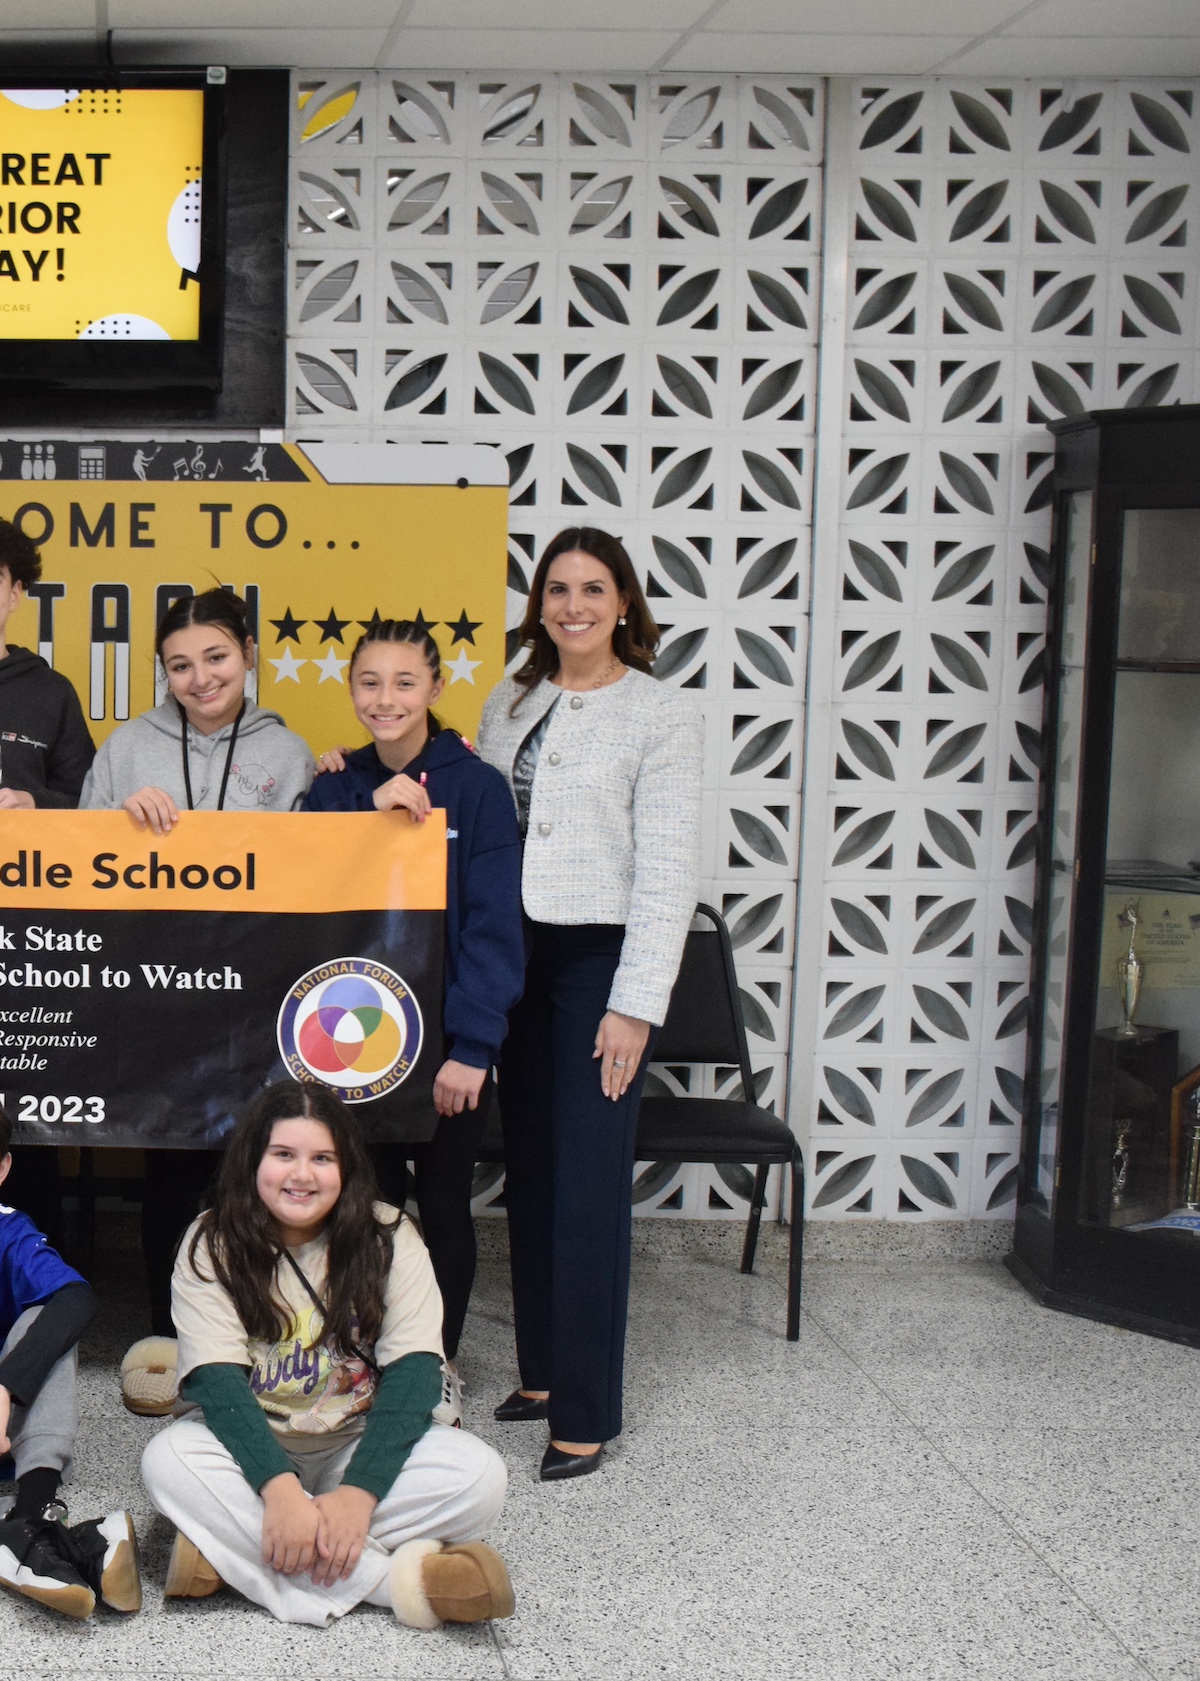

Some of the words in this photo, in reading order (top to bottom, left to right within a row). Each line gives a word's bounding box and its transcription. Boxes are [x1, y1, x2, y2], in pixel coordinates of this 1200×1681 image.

[92, 852, 256, 891] School
[25, 925, 103, 952] State
[100, 968, 131, 989] to
[140, 964, 243, 990] Watch
[292, 962, 357, 1000] NATIONAL
[363, 964, 407, 1000] FORUM
[345, 1088, 364, 1100] TO
[17, 1095, 106, 1123] 2023
